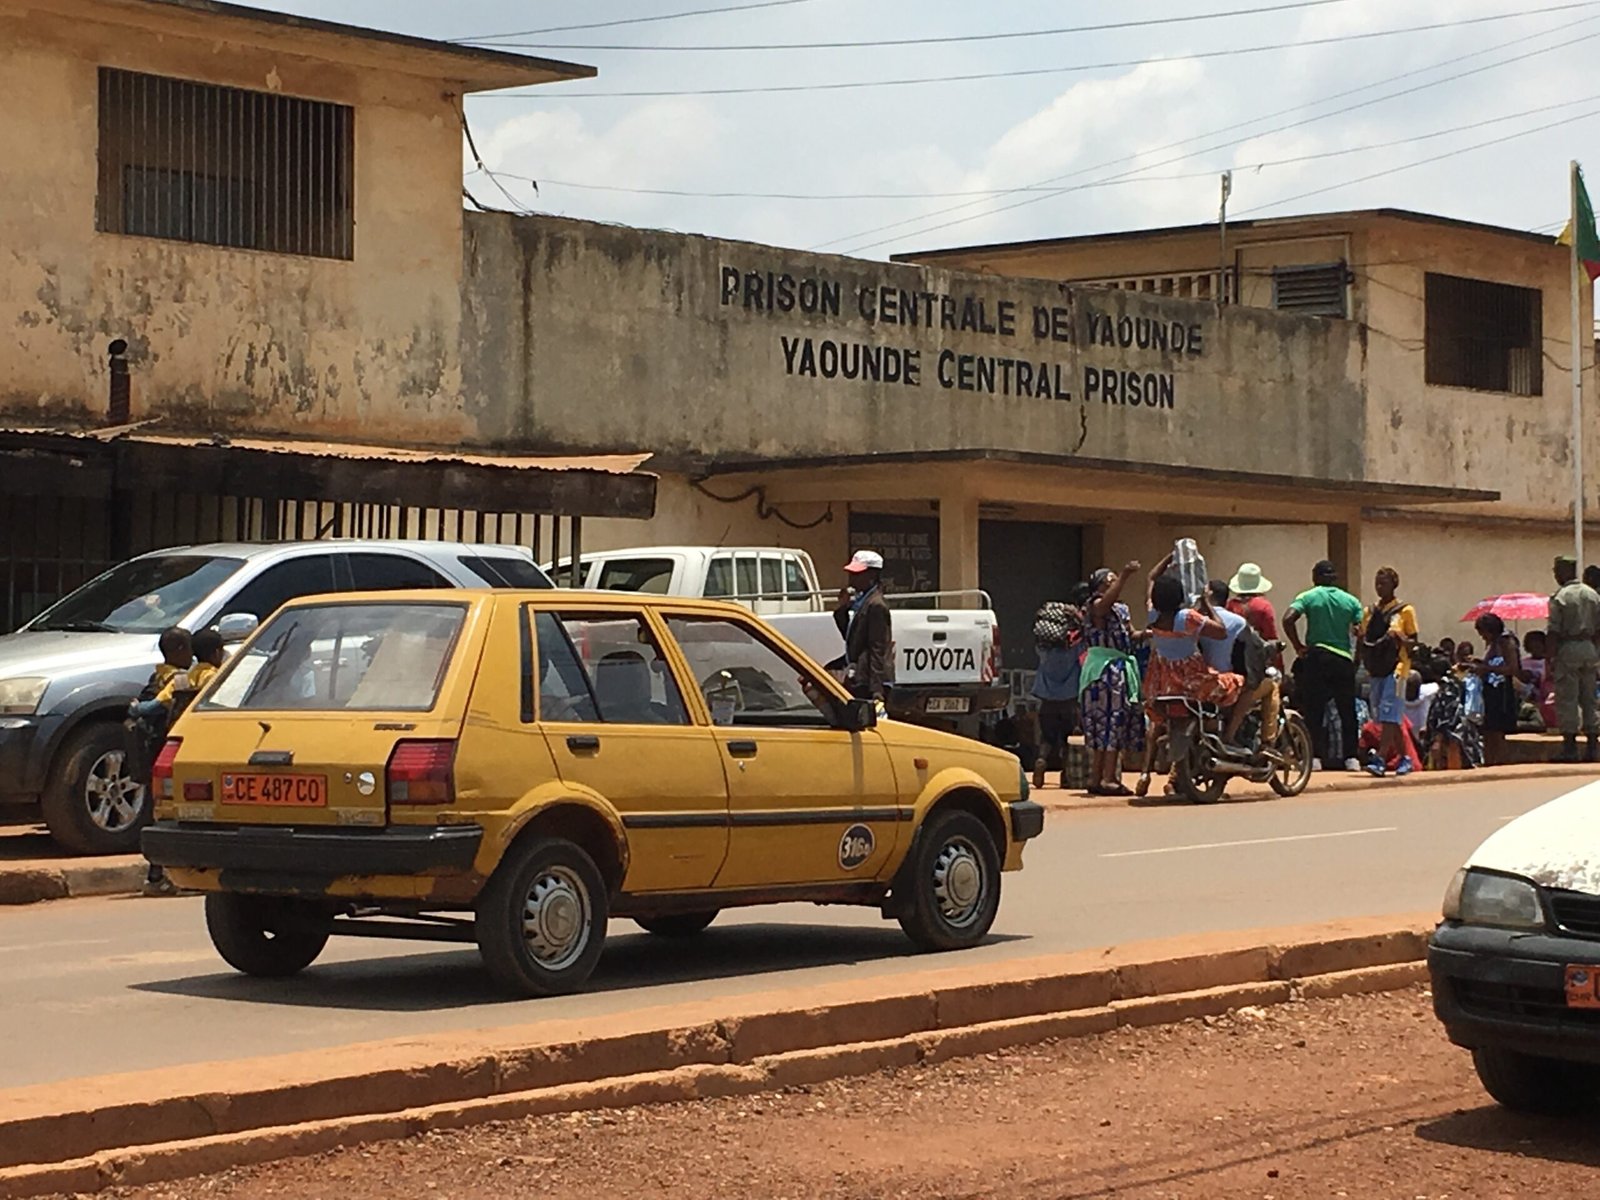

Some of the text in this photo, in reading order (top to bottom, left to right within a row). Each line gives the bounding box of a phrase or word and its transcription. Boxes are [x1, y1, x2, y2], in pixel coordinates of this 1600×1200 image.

[720, 265, 1204, 355] PRISON CENTRALE DE YAOUNDE
[781, 336, 1176, 409] YAOUNDE CENTRAL PRISON
[903, 648, 975, 671] TOYOTA
[235, 777, 257, 801] CE
[261, 777, 292, 801] 487
